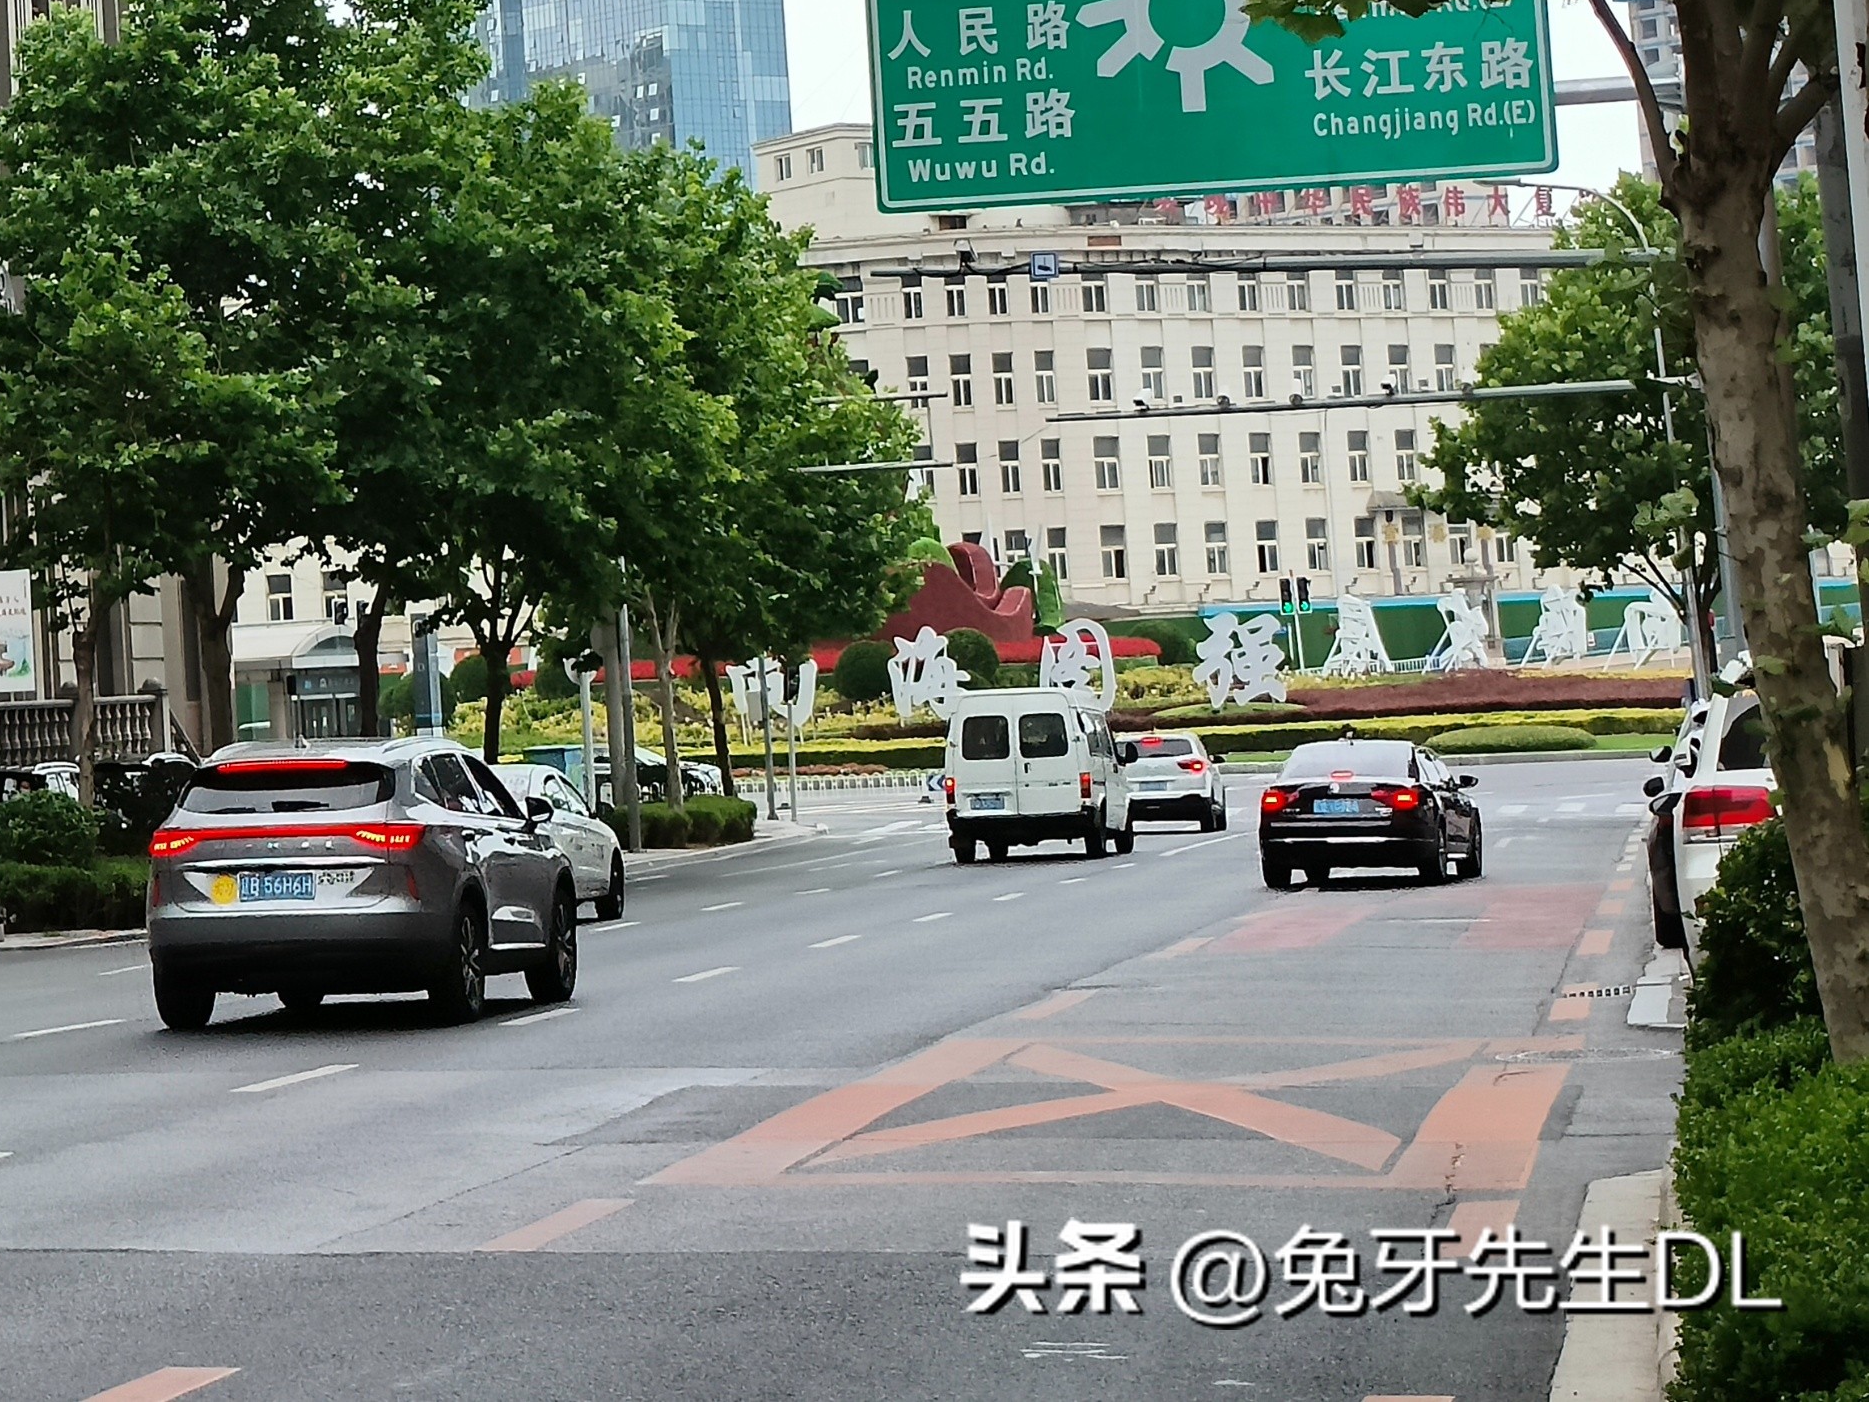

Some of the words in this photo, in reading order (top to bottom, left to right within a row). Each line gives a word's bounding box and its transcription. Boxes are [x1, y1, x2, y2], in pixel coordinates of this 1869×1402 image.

[887, 0, 1071, 61] 人民路
[907, 60, 1007, 90] Renmin
[1016, 56, 1054, 82] Rd.
[1304, 37, 1534, 102] 长江东路
[891, 88, 1076, 148] 五五路
[1312, 107, 1459, 141] Changjiang
[908, 158, 998, 184] Wuwu
[1009, 151, 1056, 177] Rd.
